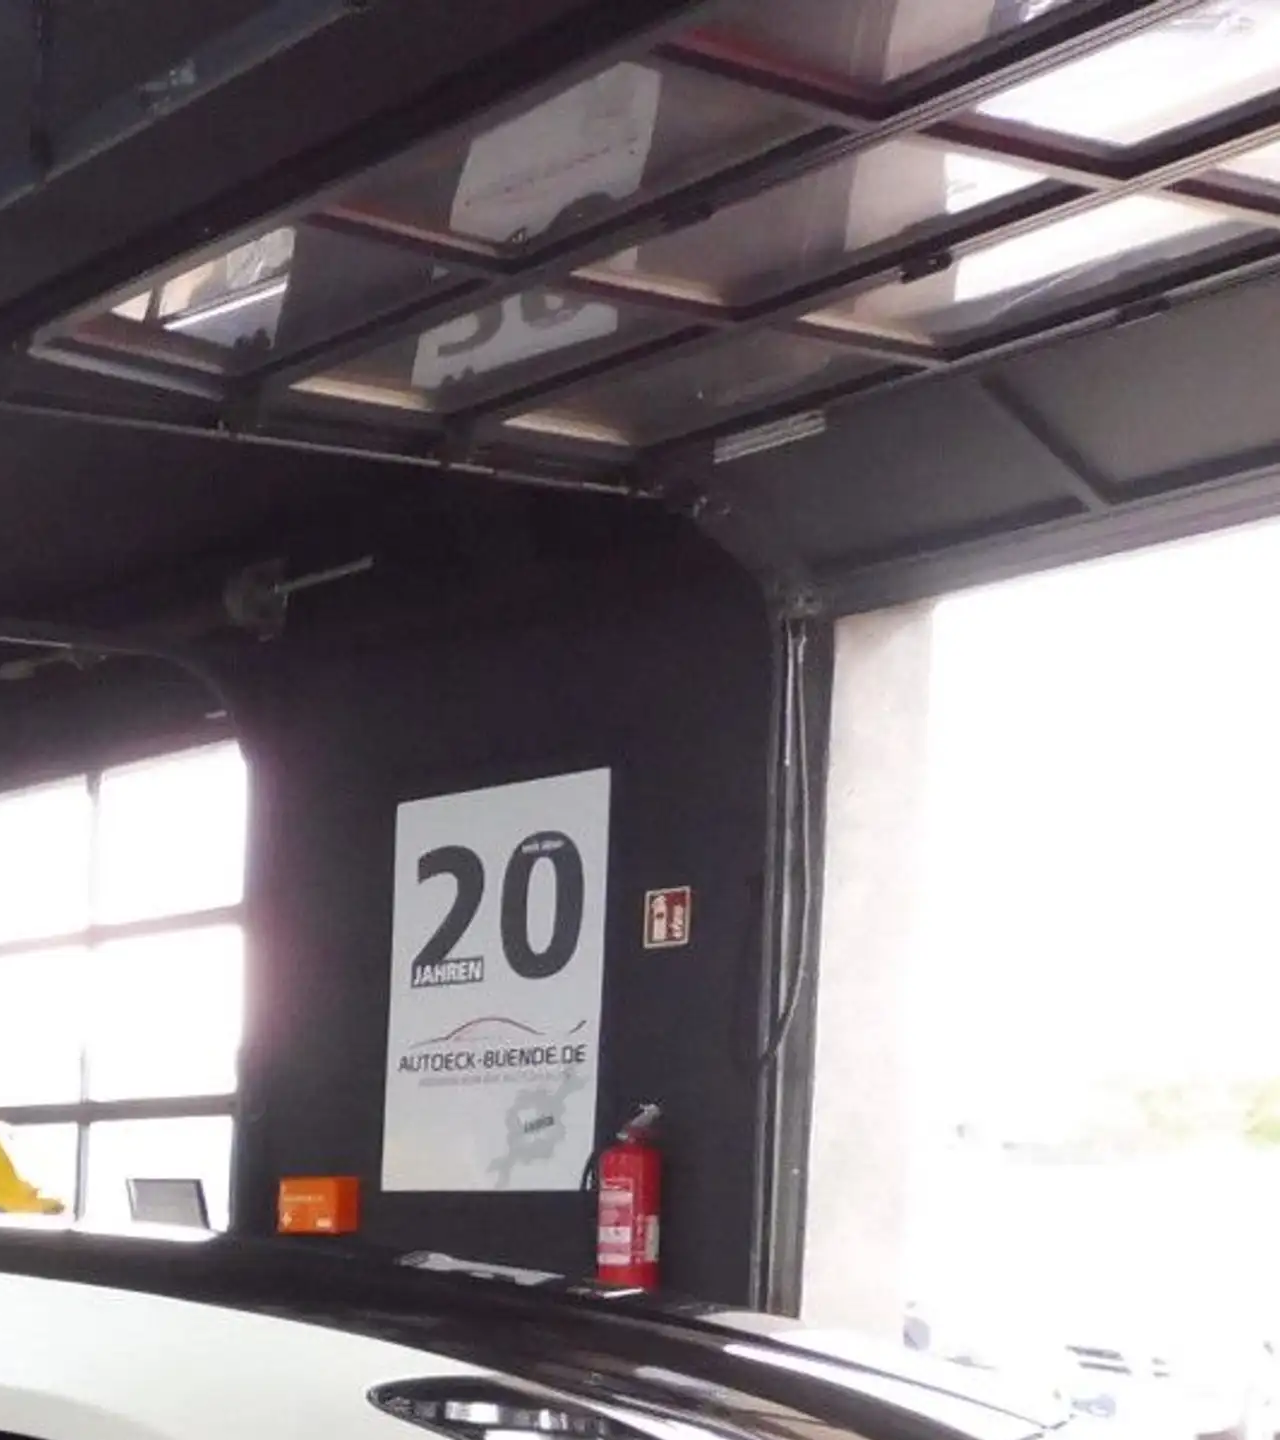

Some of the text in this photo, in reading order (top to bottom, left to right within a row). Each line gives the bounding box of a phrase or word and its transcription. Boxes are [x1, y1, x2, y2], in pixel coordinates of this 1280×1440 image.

[412, 830, 585, 981] 20
[413, 960, 483, 986] JAHREN
[397, 1044, 588, 1073] AUTOECK-BUENDE.DE
